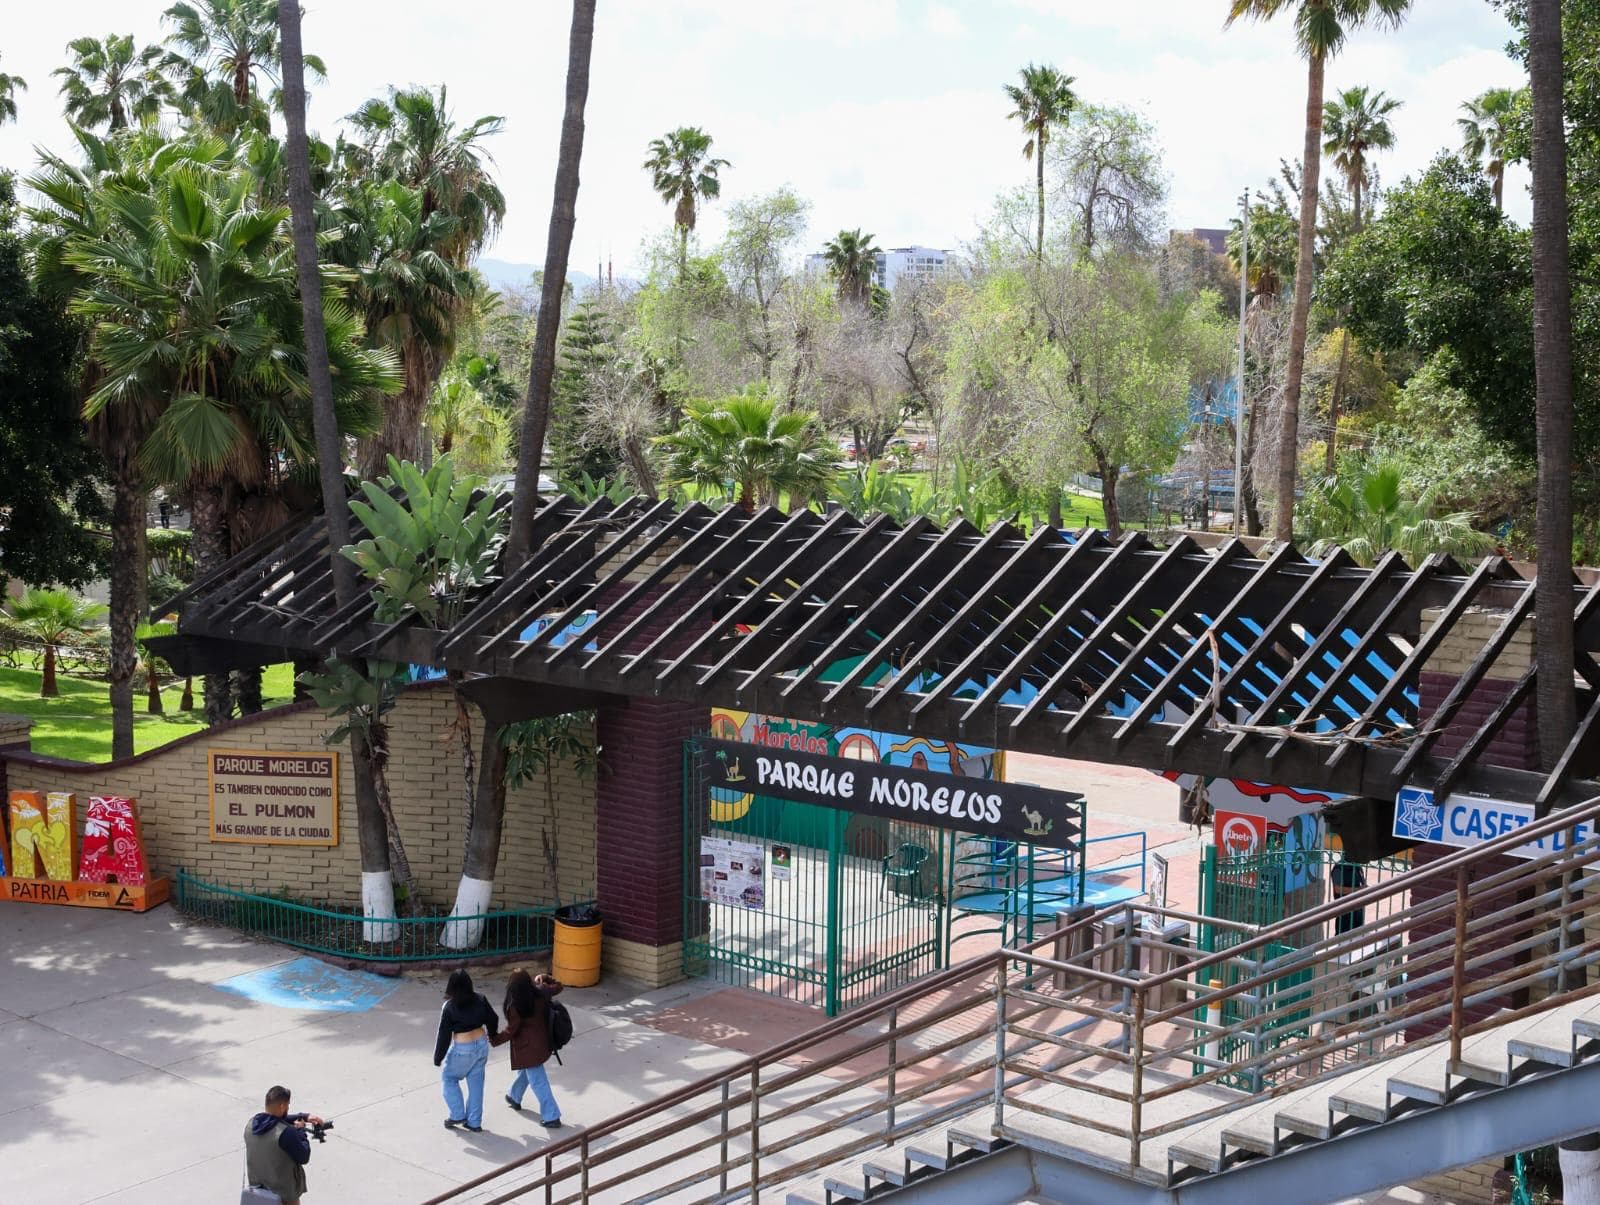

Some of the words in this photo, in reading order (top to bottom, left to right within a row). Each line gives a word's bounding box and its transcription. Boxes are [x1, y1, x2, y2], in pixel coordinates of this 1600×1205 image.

[752, 724, 828, 756] Morelos
[216, 758, 264, 773] PARQUE
[269, 761, 329, 775] MORELOS
[215, 783, 225, 793] ES
[227, 784, 262, 795] TAMBIEN
[264, 786, 307, 796] CONOCIDO
[309, 787, 332, 797] COMO
[756, 757, 855, 799] PARQUE
[869, 776, 1002, 824] MORELOS
[229, 803, 247, 816] EL
[255, 804, 315, 818] PULMON
[235, 825, 267, 836] GRANDE
[270, 826, 280, 836] DE
[284, 827, 296, 837] LA
[11, 882, 70, 901] PATRIA
